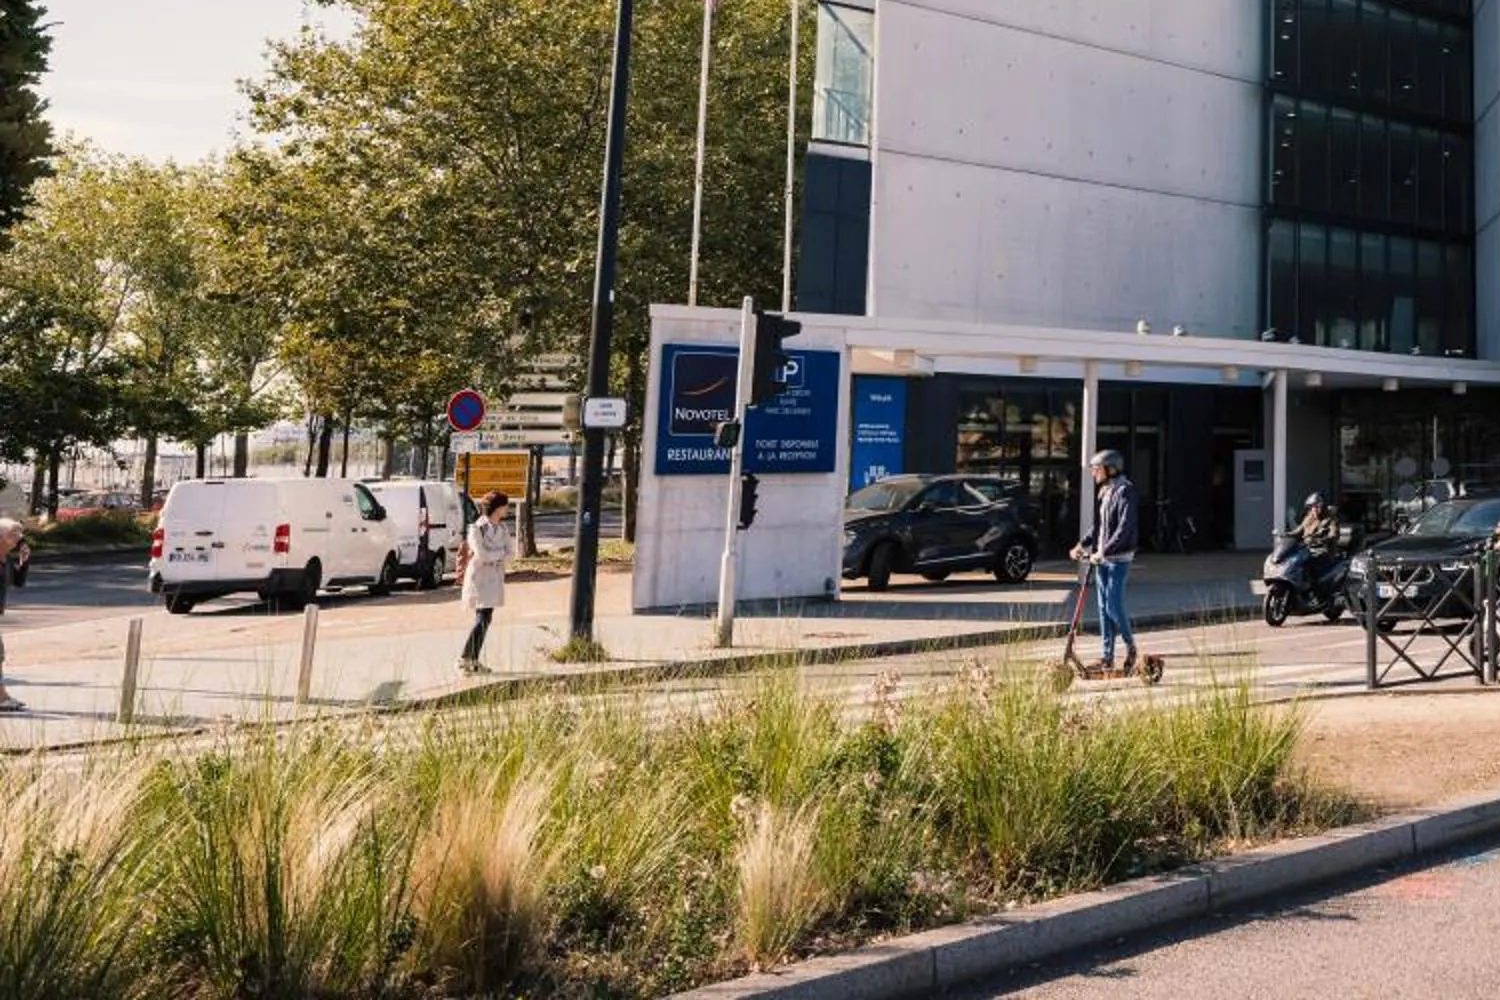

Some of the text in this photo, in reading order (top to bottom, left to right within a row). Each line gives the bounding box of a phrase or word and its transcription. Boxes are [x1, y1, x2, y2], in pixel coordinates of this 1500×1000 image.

[783, 361, 799, 382] P
[674, 407, 731, 421] NOVOTEL
[667, 447, 731, 461] RESTAURAN
